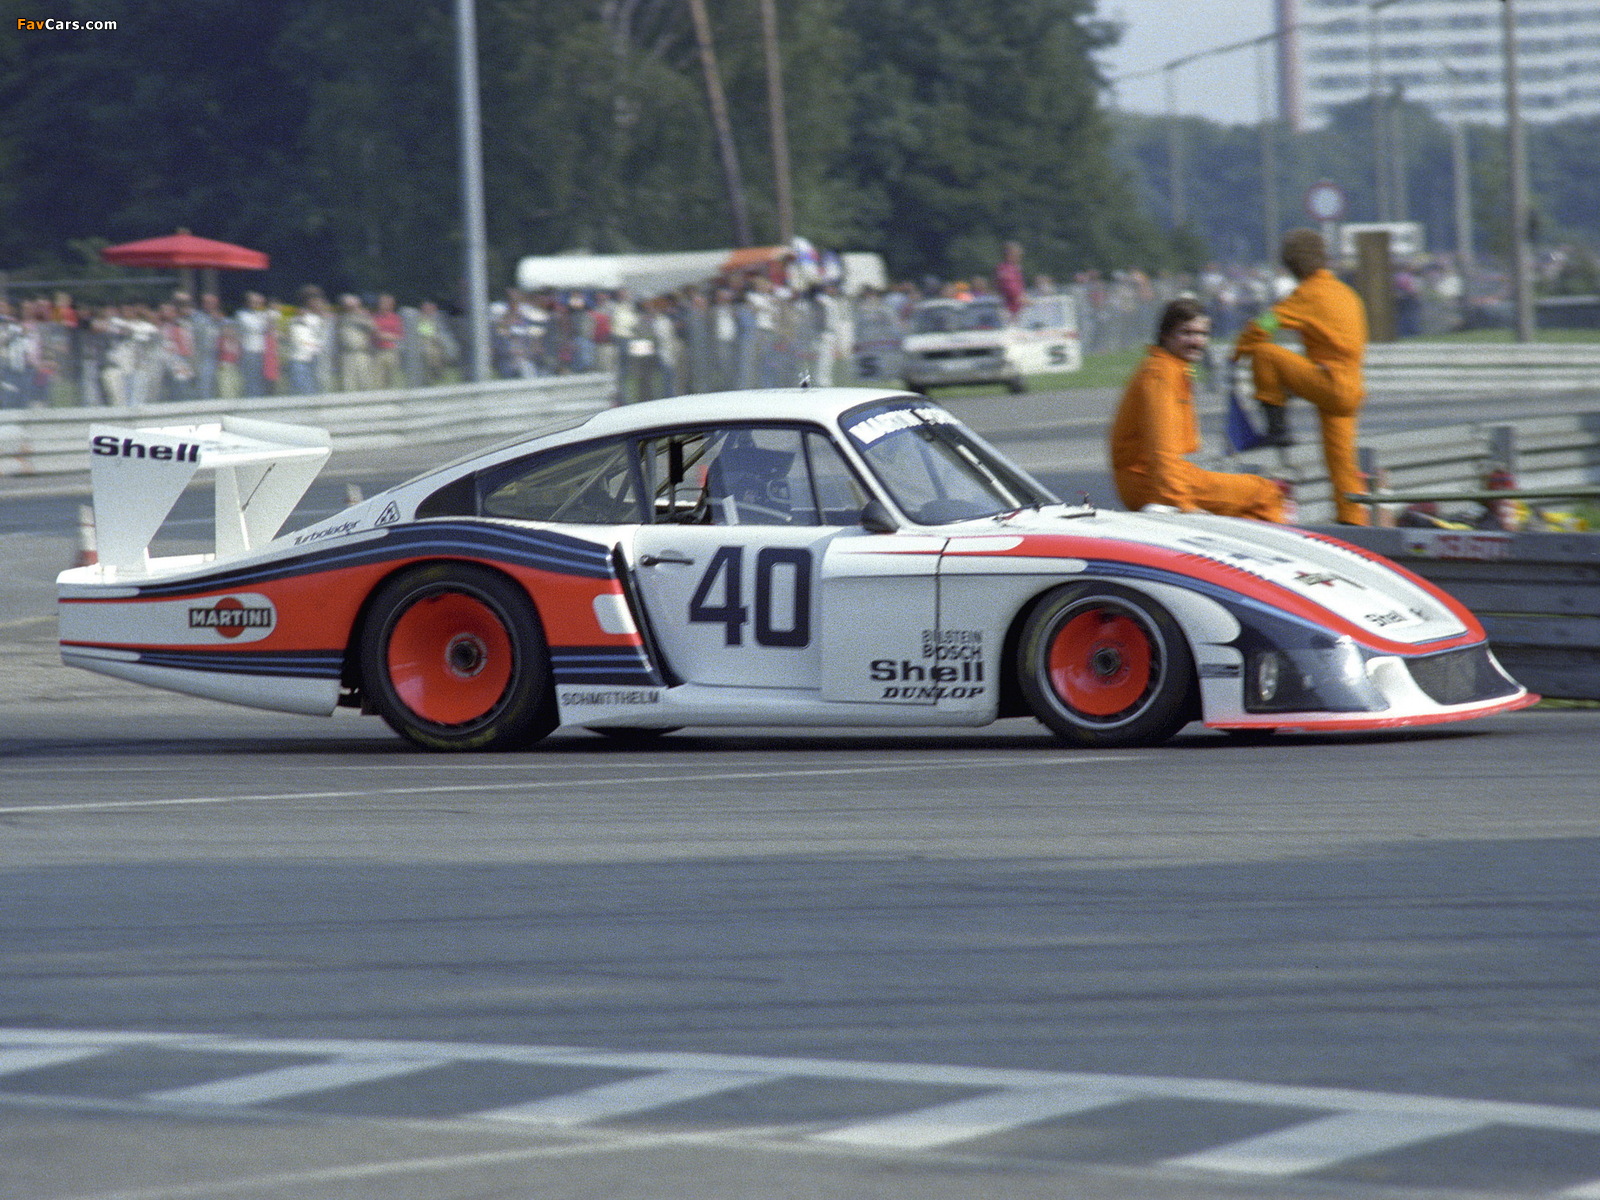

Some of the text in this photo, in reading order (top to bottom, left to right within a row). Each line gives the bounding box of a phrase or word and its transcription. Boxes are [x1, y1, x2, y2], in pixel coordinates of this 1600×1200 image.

[93, 436, 200, 462] Shell
[294, 520, 361, 545] Turbolader
[689, 546, 811, 647] 40
[190, 609, 270, 627] MARTINI
[923, 644, 981, 660] BOSCH
[871, 660, 983, 681] Shell
[882, 687, 984, 698] DUNLOP
